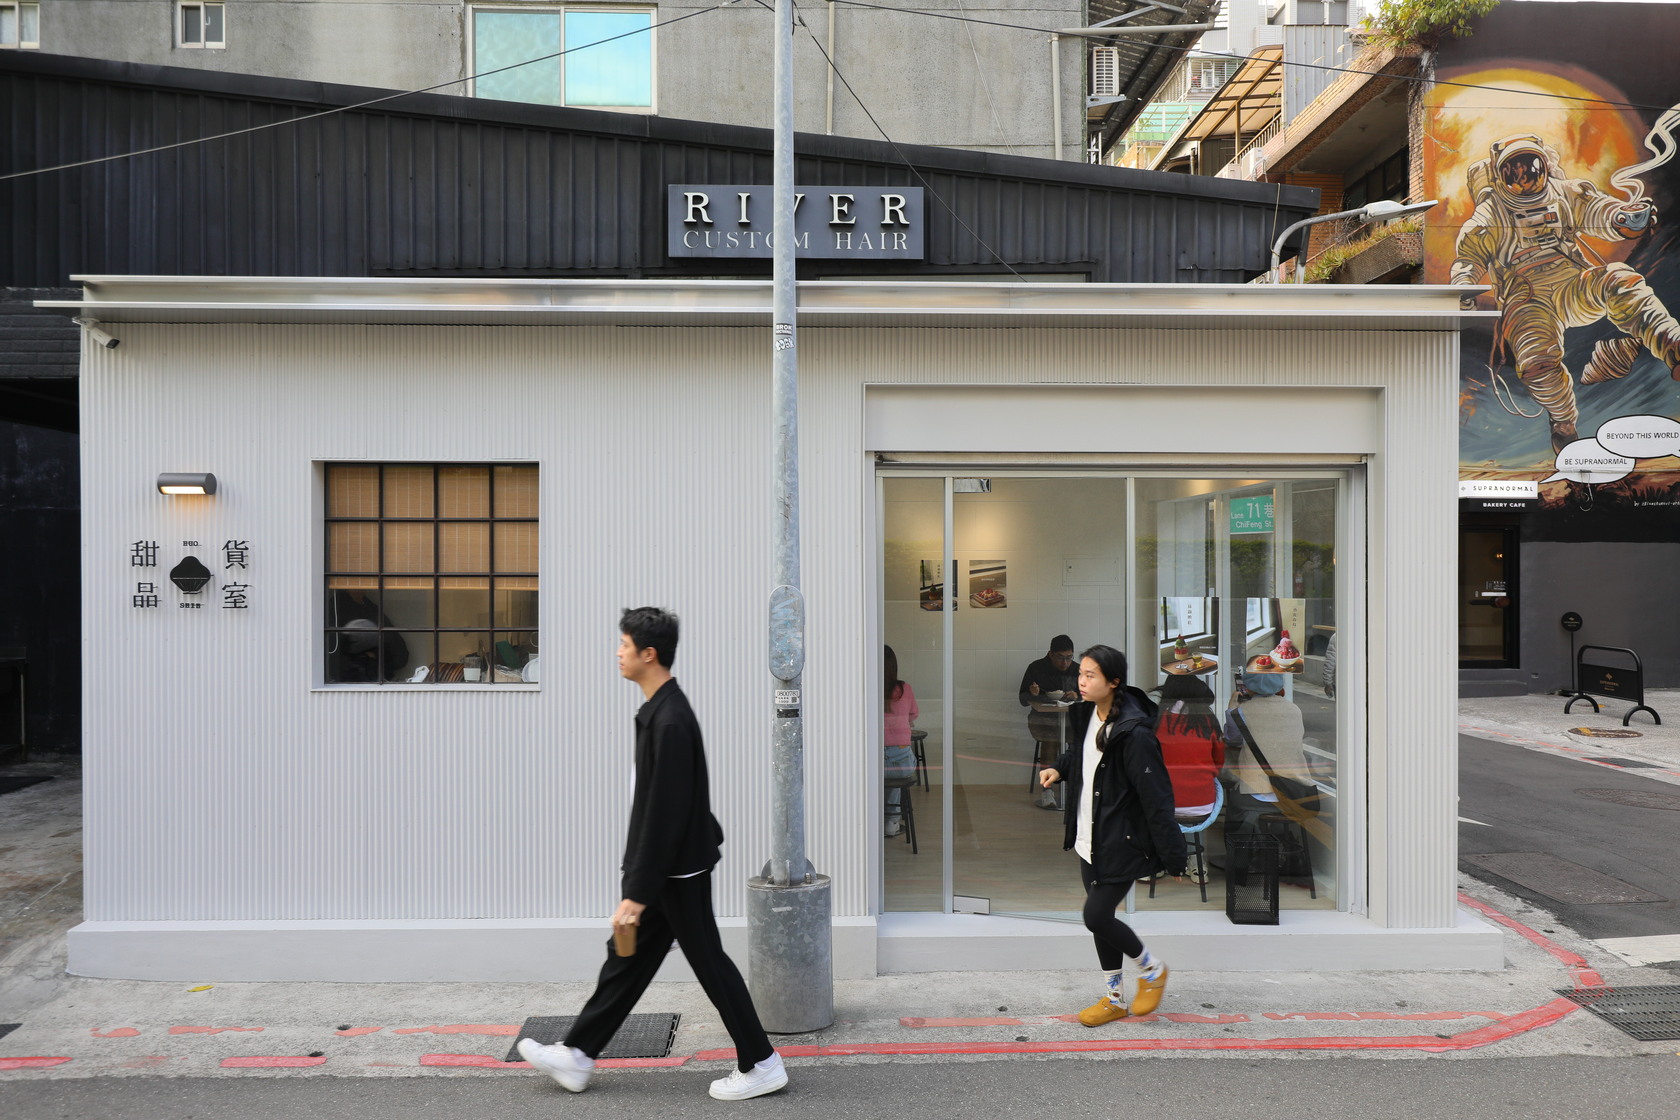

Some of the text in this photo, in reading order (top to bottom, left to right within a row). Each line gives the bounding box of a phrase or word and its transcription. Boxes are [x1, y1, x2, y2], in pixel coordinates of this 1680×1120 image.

[683, 192, 910, 225] RIER
[835, 232, 908, 251] HAIR
[1606, 432, 1634, 440] BEYOND
[1564, 457, 1628, 466] BE SUPRANORMAL
[1246, 503, 1260, 518] 71
[1235, 520, 1262, 529] ChiFeng
